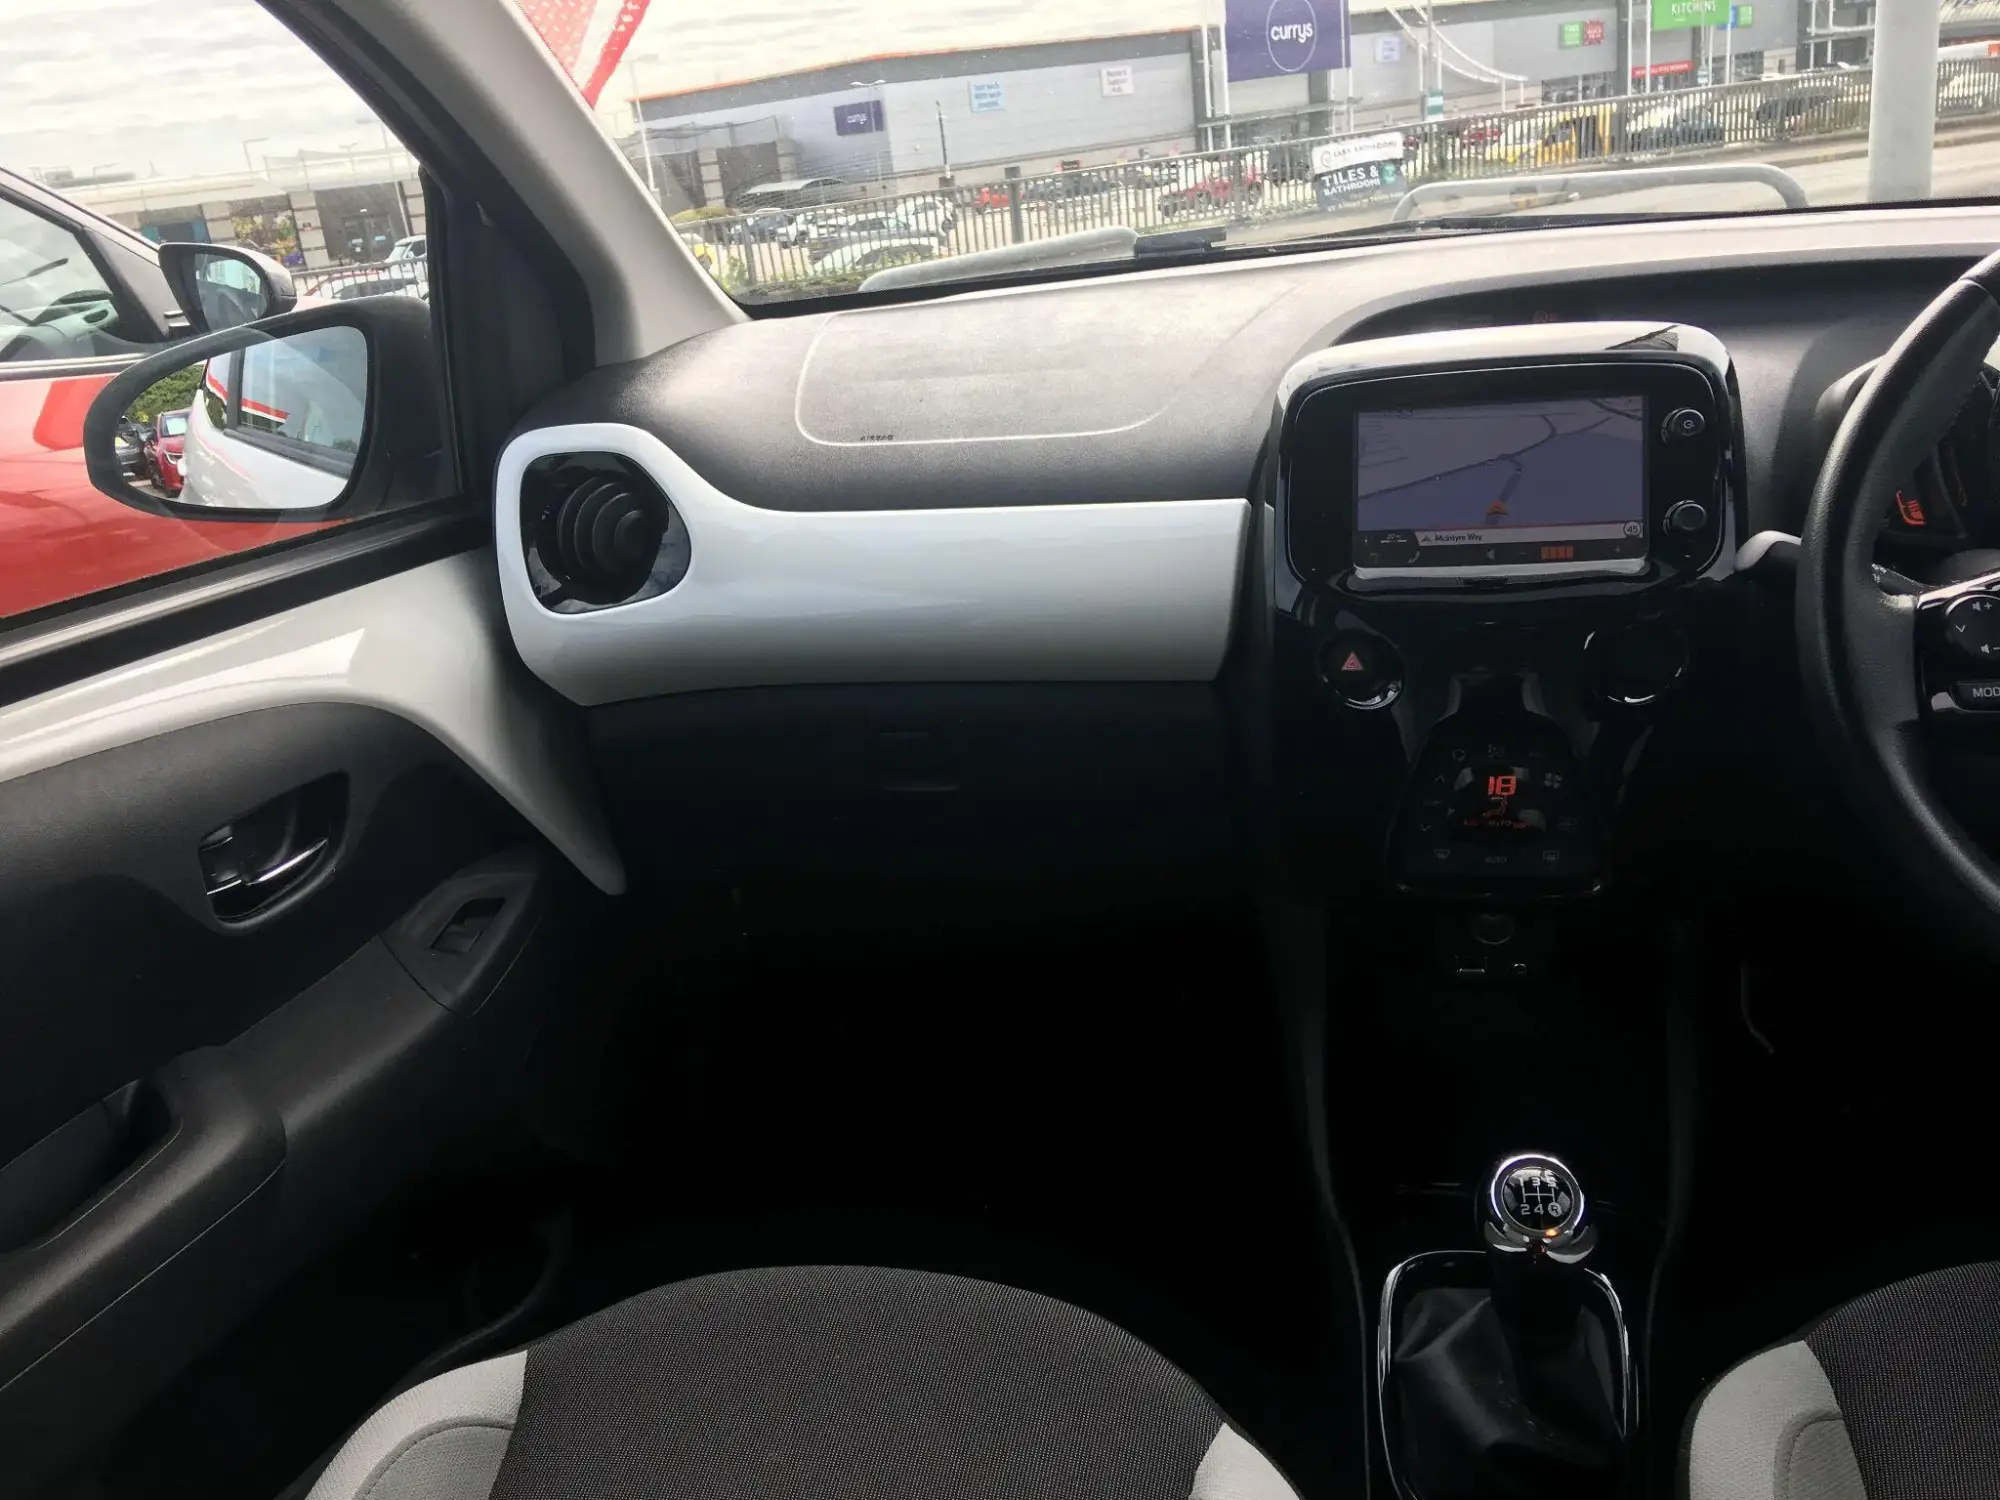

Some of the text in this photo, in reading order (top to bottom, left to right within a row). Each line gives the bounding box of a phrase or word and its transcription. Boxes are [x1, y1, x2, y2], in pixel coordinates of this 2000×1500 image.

[1270, 22, 1314, 43] currys
[1321, 165, 1379, 187] TILES &
[1626, 525, 1639, 534] 45
[1467, 532, 1483, 541] Way
[1972, 686, 2000, 698] MOD
[1487, 775, 1516, 796] 18
[1531, 1176, 1541, 1186] 3
[1520, 1203, 1531, 1216] 2
[1533, 1203, 1544, 1216] 4
